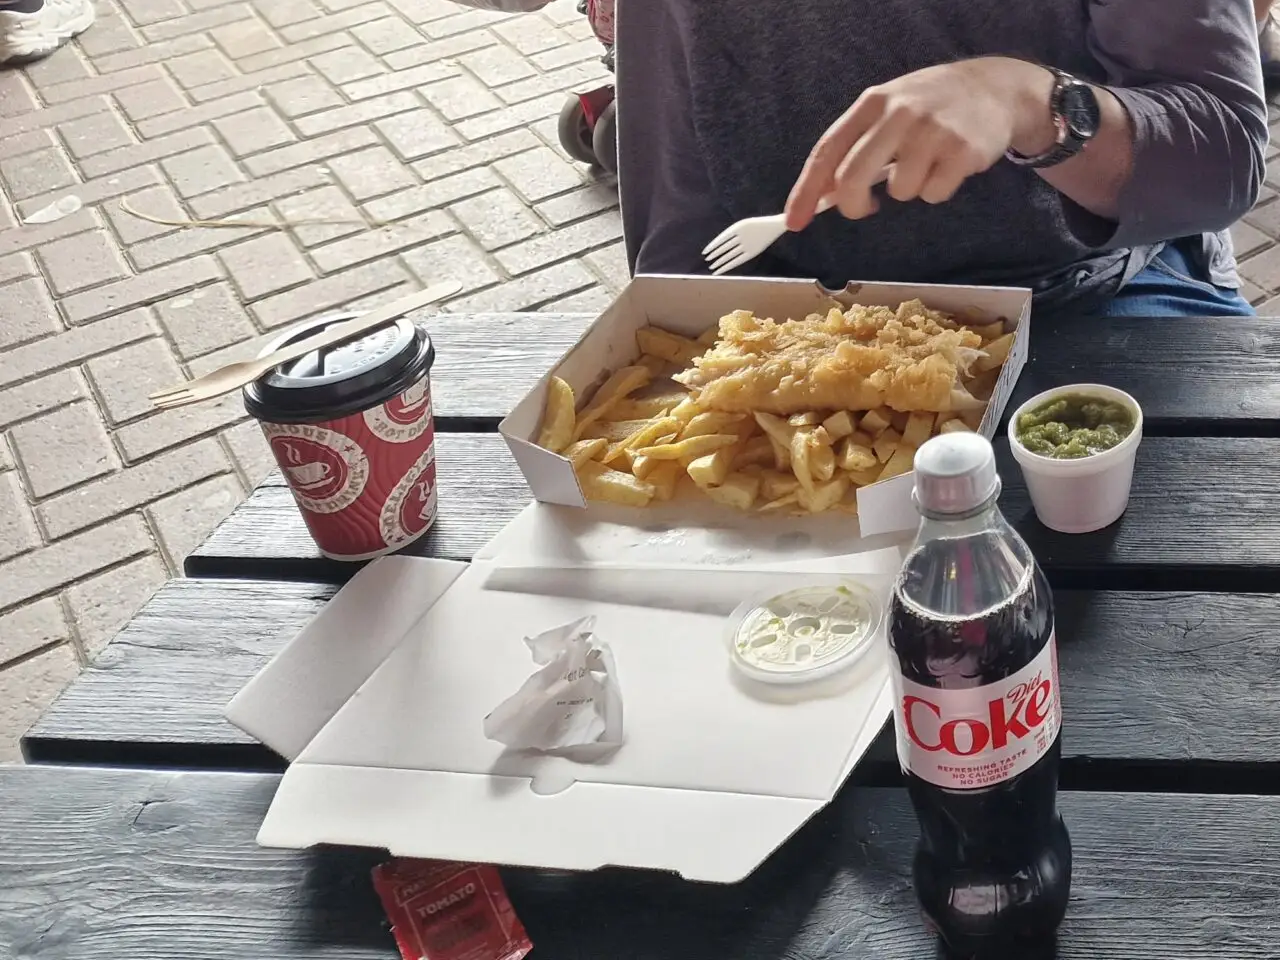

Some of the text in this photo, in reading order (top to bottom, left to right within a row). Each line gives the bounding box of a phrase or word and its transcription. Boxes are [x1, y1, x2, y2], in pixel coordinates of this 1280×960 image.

[1006, 670, 1042, 705] Diet
[903, 679, 1051, 757] Coke
[937, 749, 1027, 774] REFRESHING TASTE
[952, 762, 1015, 780] NO CALORIES
[960, 772, 1008, 786] NO SUGAR
[416, 882, 477, 919] TOMATO
